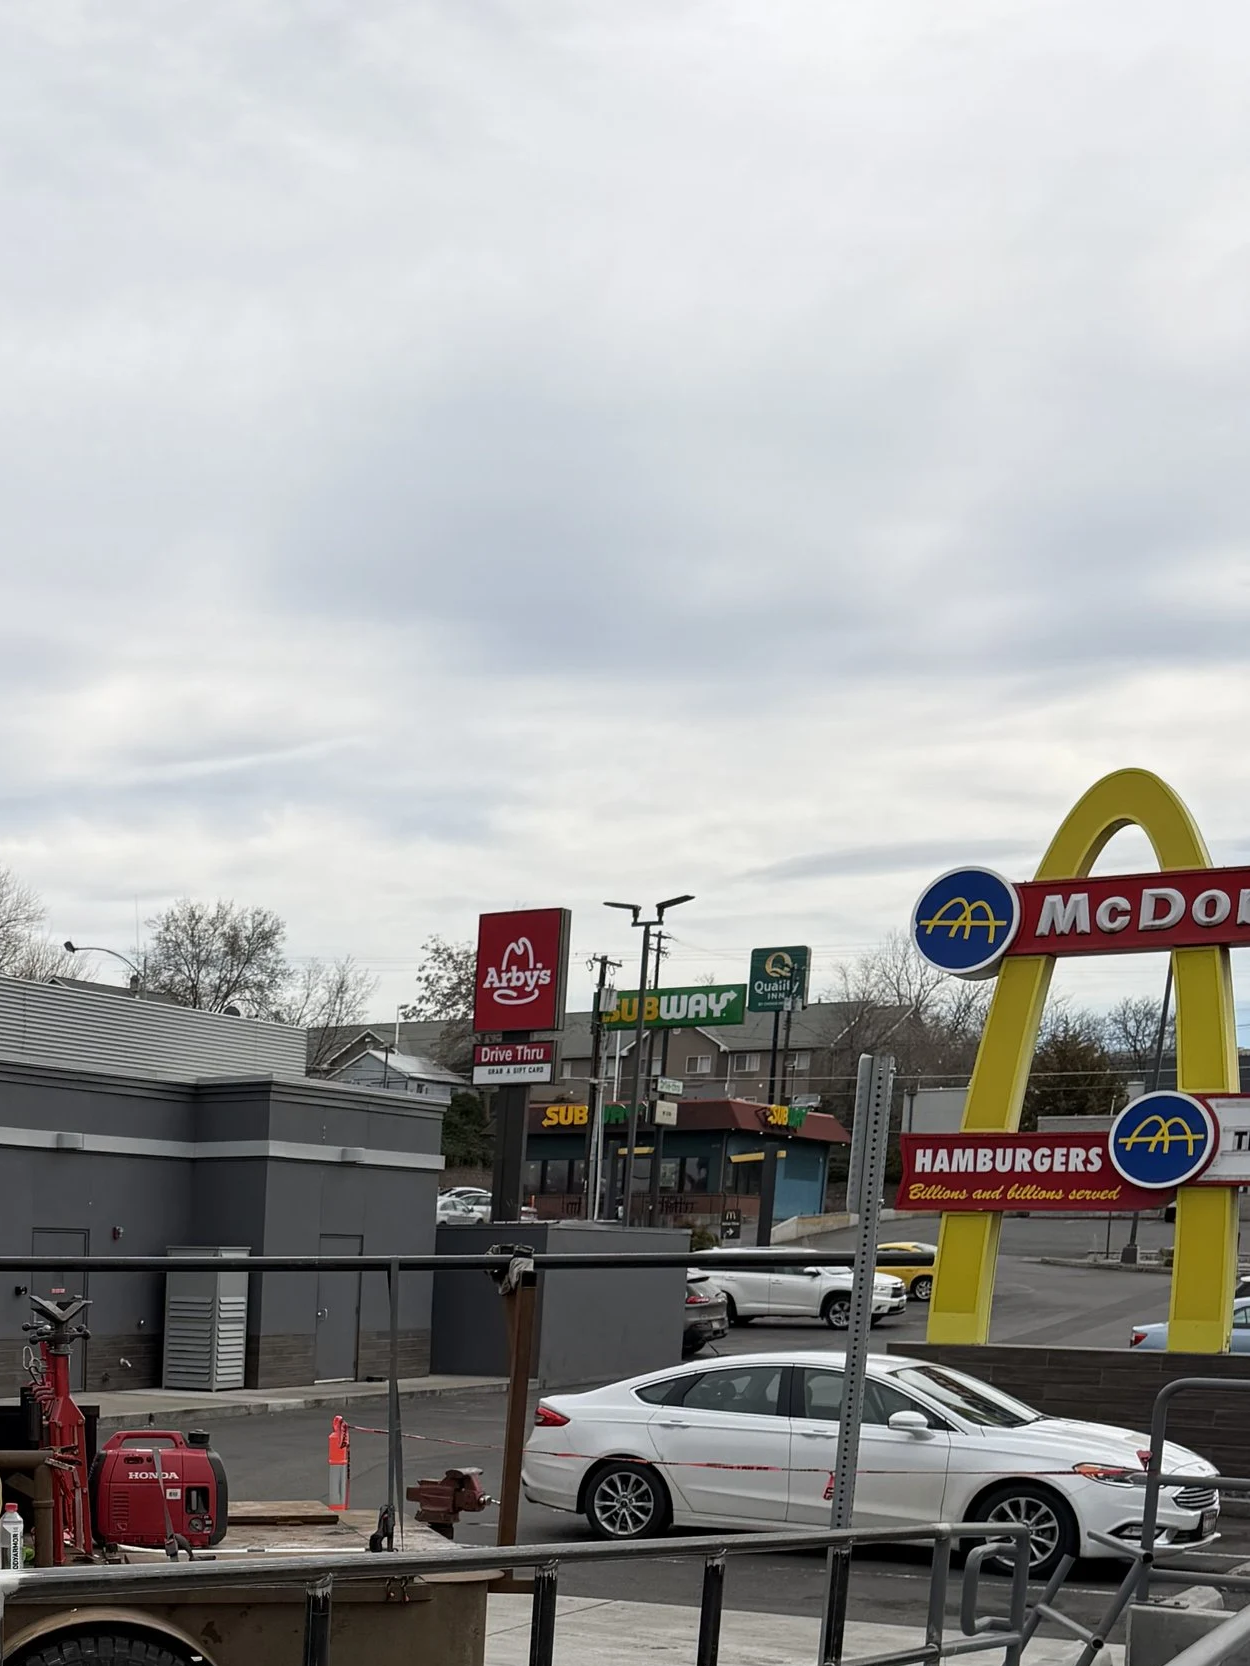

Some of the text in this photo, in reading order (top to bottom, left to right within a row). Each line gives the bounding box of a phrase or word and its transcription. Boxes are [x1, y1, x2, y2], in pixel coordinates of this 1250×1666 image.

[1035, 888, 1250, 936] McDo
[482, 962, 552, 992] Arby's
[767, 992, 786, 1000] INN
[481, 1045, 545, 1062] Drive Thru
[1234, 1130, 1250, 1151] T
[914, 1147, 1103, 1173] HAMBURGERS
[908, 1182, 1122, 1200] Billions and billions served
[128, 1472, 179, 1480] HONDA
